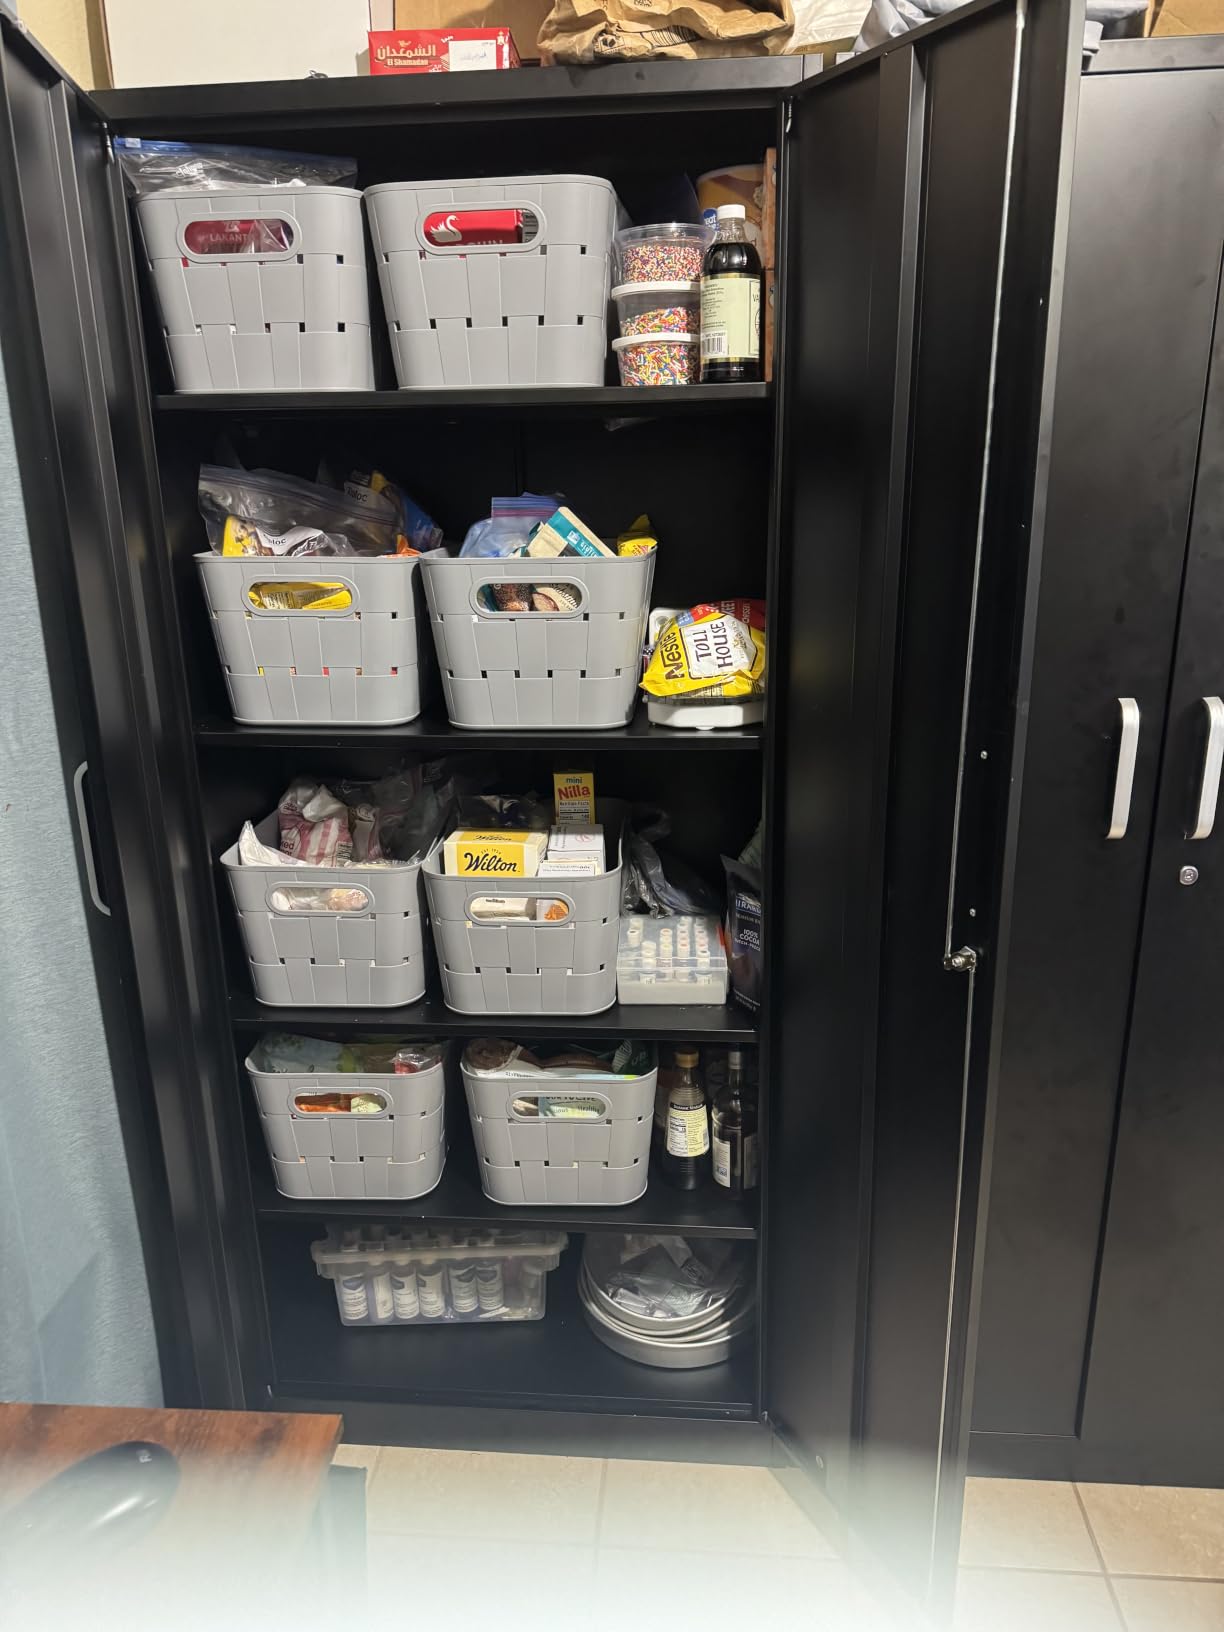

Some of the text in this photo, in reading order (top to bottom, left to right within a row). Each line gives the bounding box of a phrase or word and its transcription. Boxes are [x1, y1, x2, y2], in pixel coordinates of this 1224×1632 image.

[377, 42, 436, 60] الشمعدان
[692, 630, 712, 662] TOLL
[710, 621, 733, 668] HOUSE
[565, 776, 583, 785] mini
[557, 784, 591, 800] Nilla
[463, 851, 518, 873] Wilton
[739, 933, 760, 945] COCOA
[743, 928, 759, 939] 100%
